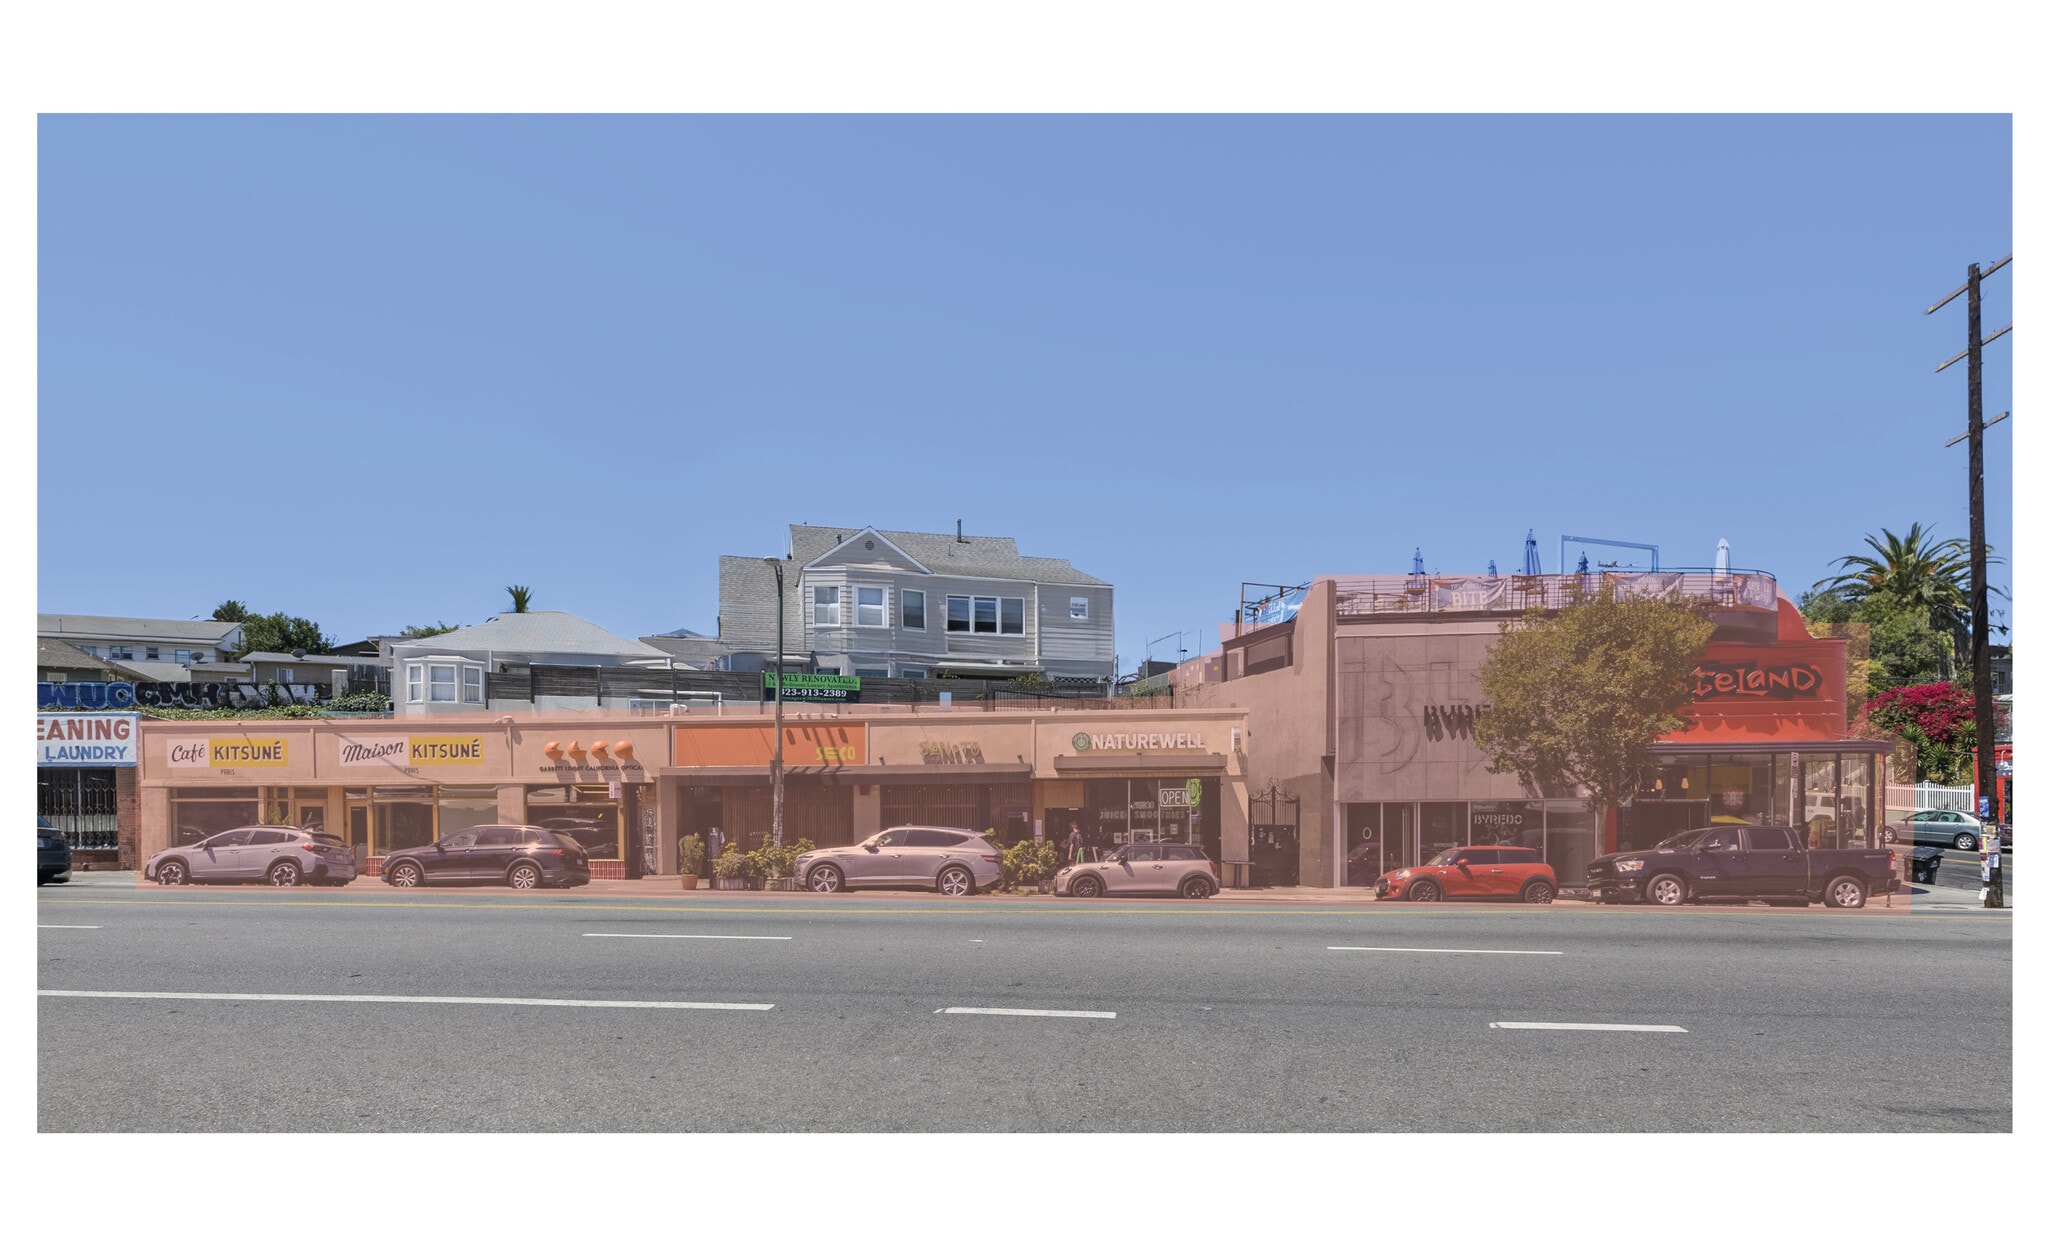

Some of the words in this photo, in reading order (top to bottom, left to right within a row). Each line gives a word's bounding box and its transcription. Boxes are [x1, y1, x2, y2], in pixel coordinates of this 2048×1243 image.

[1451, 591, 1488, 606] BITE
[1092, 733, 1207, 750] NATUREWELL
[45, 746, 128, 761] LAUNDRY
[172, 744, 205, 762] Café
[214, 741, 282, 761] KITSUNÉ
[343, 742, 404, 763] Maison
[412, 739, 481, 760] KITSUNÉ
[815, 746, 856, 761] SECO
[220, 768, 235, 776] PARIS
[585, 764, 619, 772] CALIFORNIA
[1161, 790, 1189, 805] OPEN
[1474, 814, 1523, 825] BYREDO
